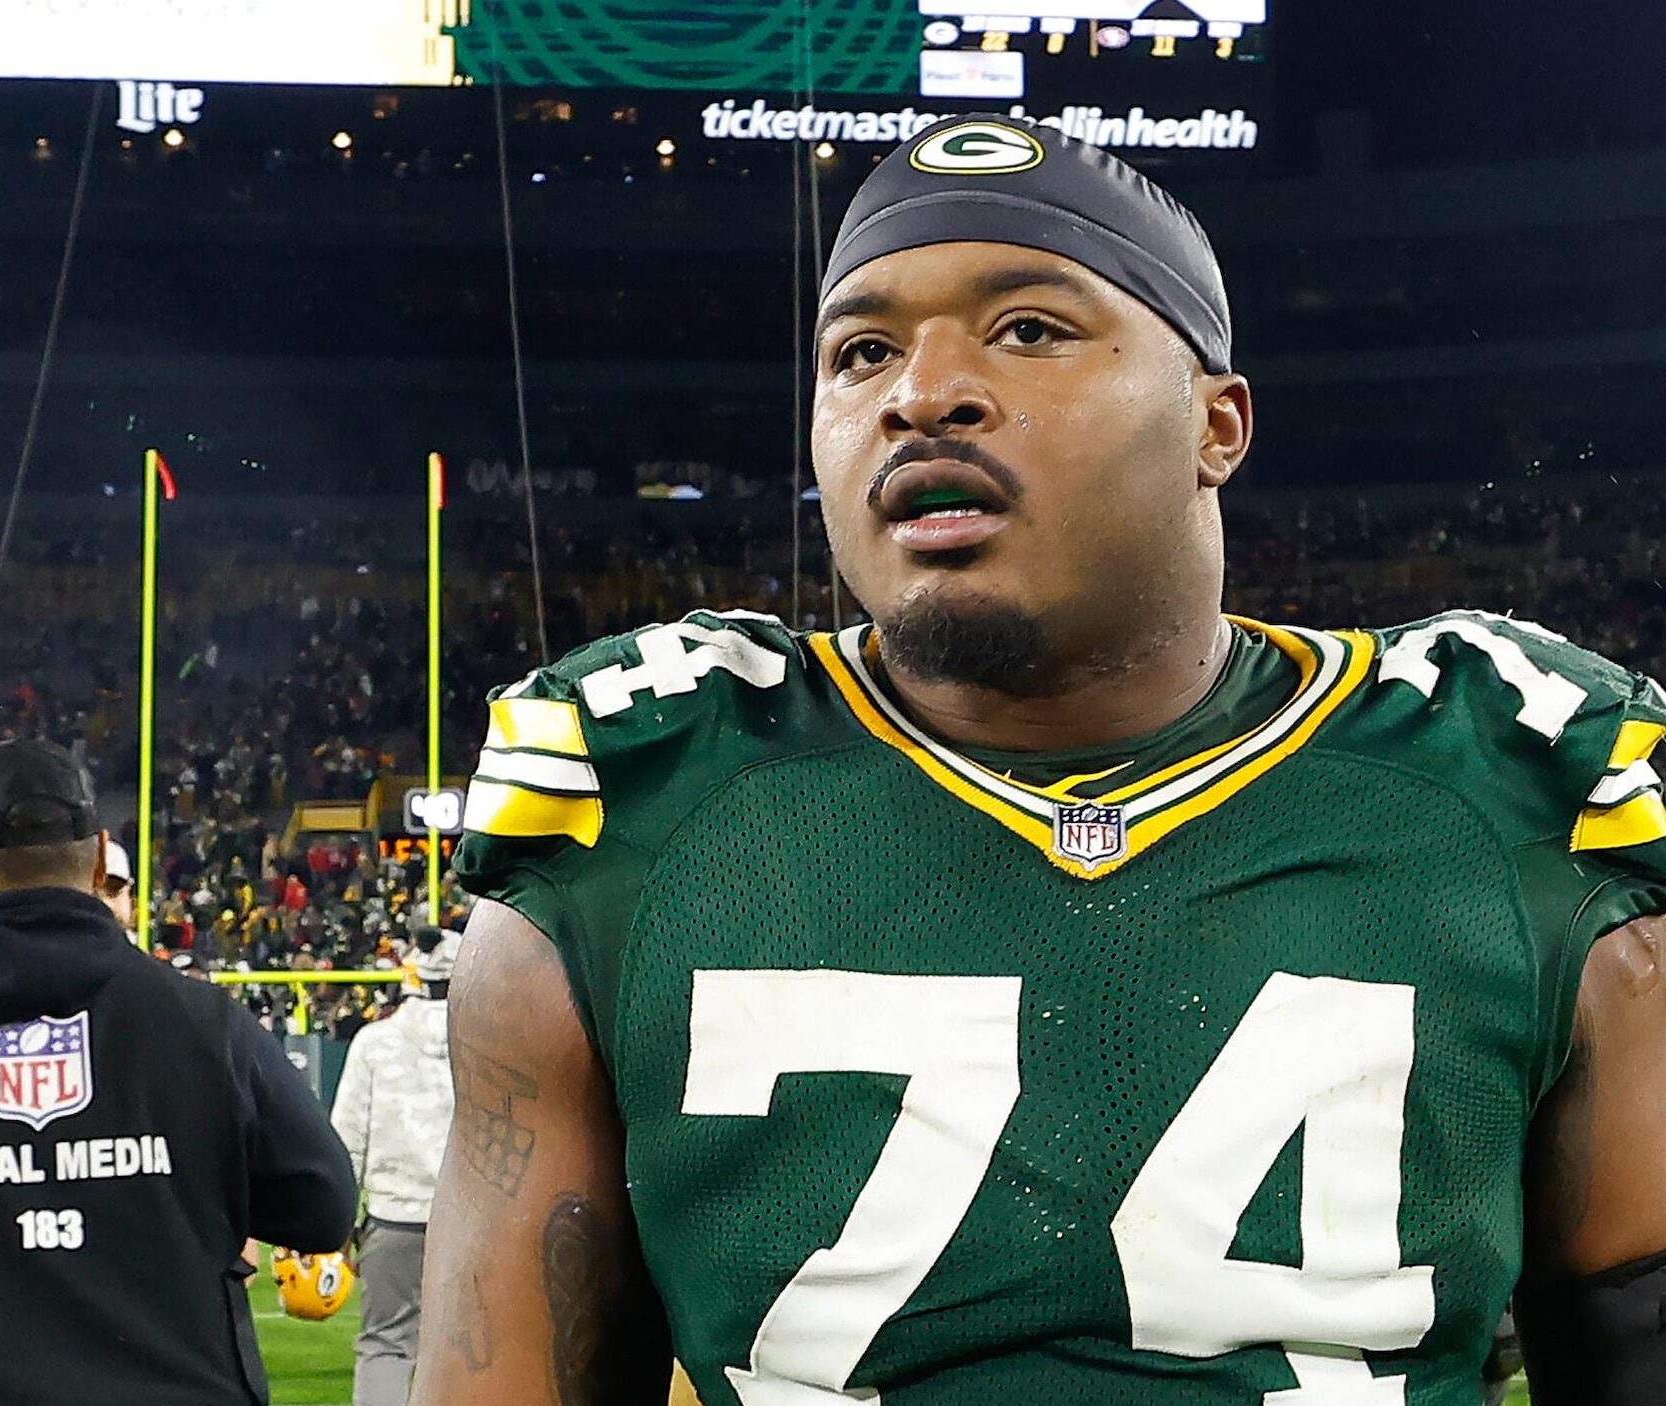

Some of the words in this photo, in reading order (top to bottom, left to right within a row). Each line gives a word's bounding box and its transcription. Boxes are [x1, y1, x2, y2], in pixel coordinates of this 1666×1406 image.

[116, 79, 204, 133] Lite
[702, 99, 957, 142] ticketmaste
[1009, 105, 1257, 149] llinhealth
[1065, 824, 1115, 853] NFL
[55, 1135, 172, 1181] MEDIA
[16, 1208, 84, 1250] 183
